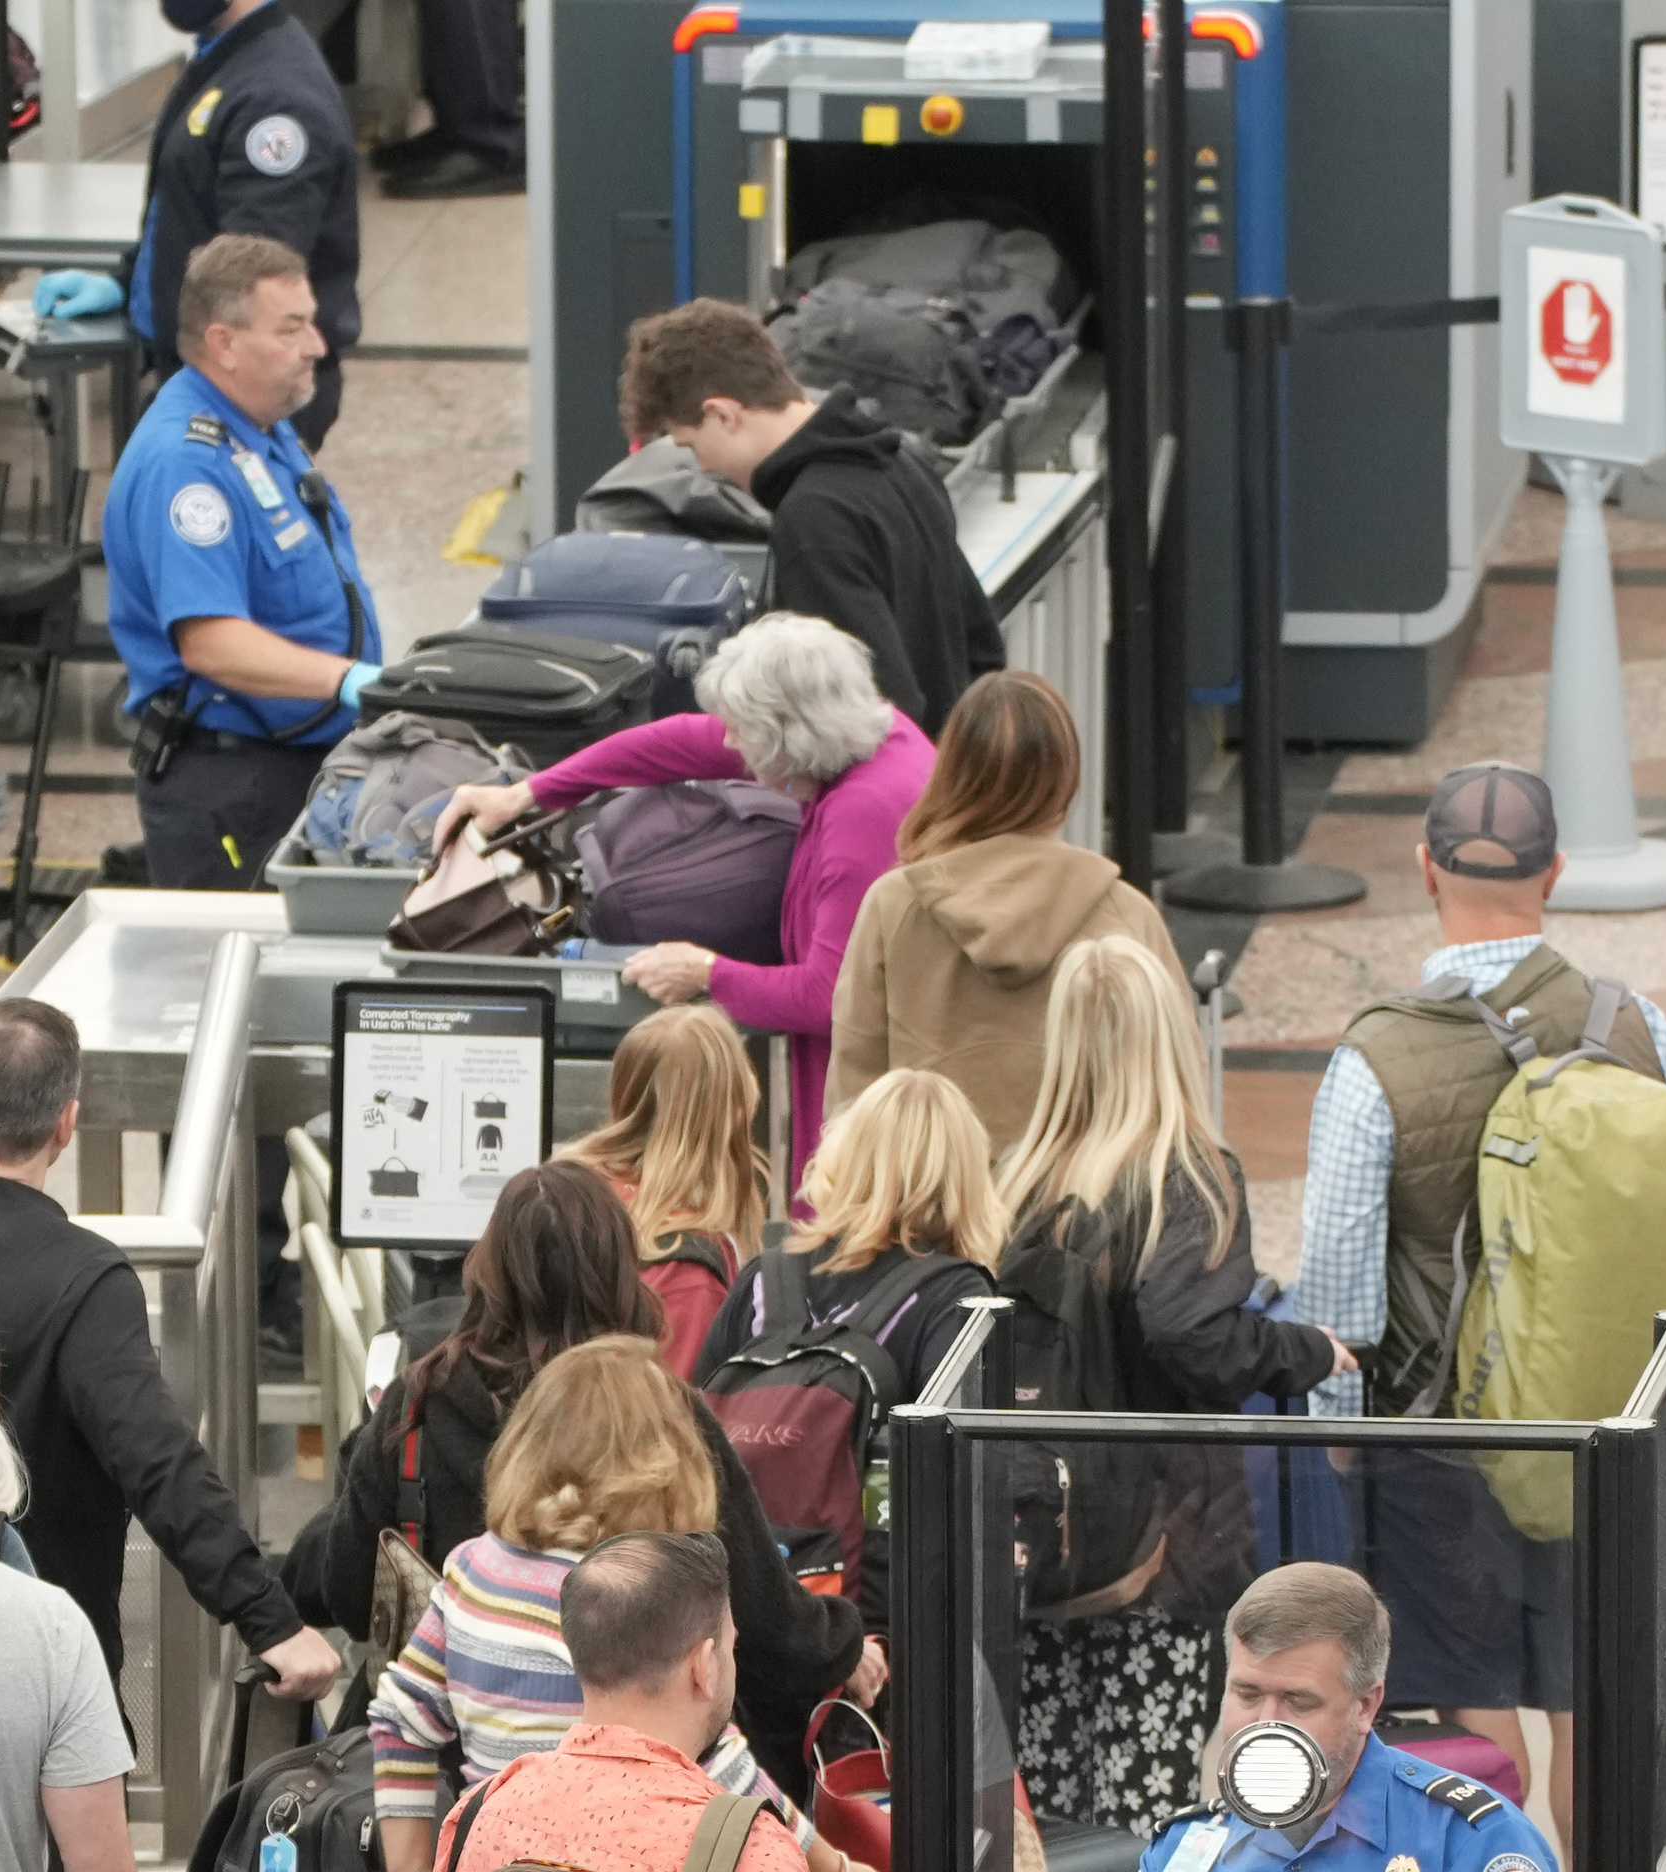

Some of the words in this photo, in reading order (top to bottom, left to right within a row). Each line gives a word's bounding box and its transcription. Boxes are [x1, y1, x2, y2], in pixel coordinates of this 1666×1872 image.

[360, 1009, 408, 1020] Computed
[410, 1010, 471, 1023] Tomography
[360, 1020, 369, 1029] In
[371, 1020, 389, 1029] Use
[390, 1020, 404, 1030] On
[405, 1021, 426, 1030] This
[427, 1021, 451, 1031] Lane
[1447, 1783, 1483, 1801] TSA
